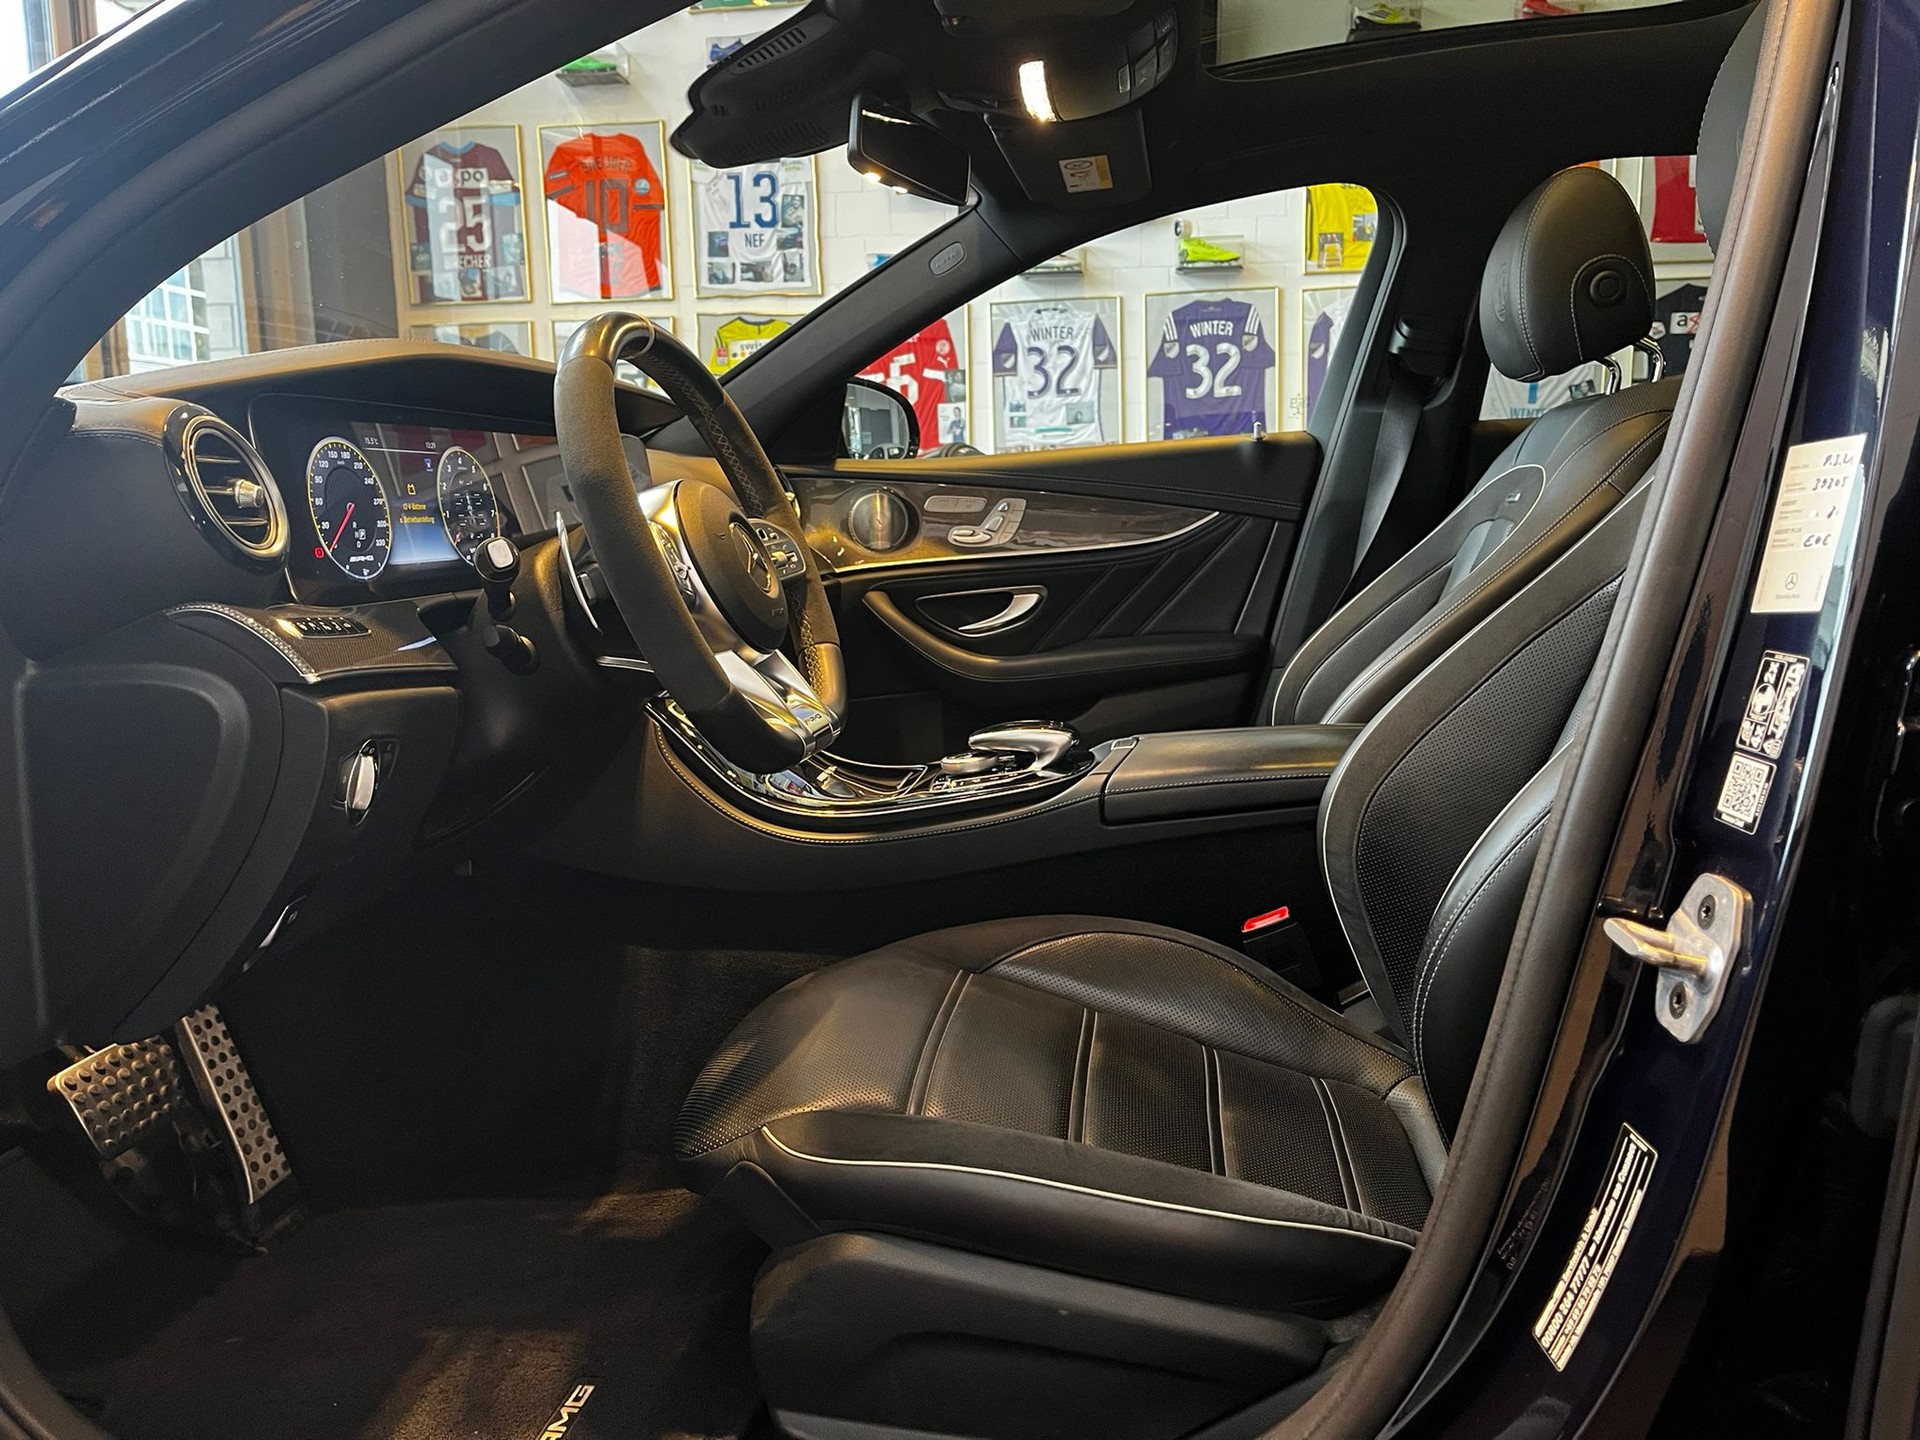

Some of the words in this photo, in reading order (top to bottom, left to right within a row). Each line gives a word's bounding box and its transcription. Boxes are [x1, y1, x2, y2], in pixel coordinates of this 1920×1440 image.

[585, 178, 628, 233] 10
[726, 171, 781, 229] 13
[438, 196, 491, 253] 25
[745, 233, 765, 248] NEF
[1029, 326, 1075, 343] WINTER
[1189, 320, 1234, 338] WINTER
[1027, 345, 1082, 399] 32
[1185, 342, 1243, 399] 32
[314, 475, 323, 484] 90
[318, 460, 329, 468] 120
[321, 521, 330, 530] 30
[1540, 1311, 1565, 1348] 00800
[1569, 1255, 1589, 1293] 77777
